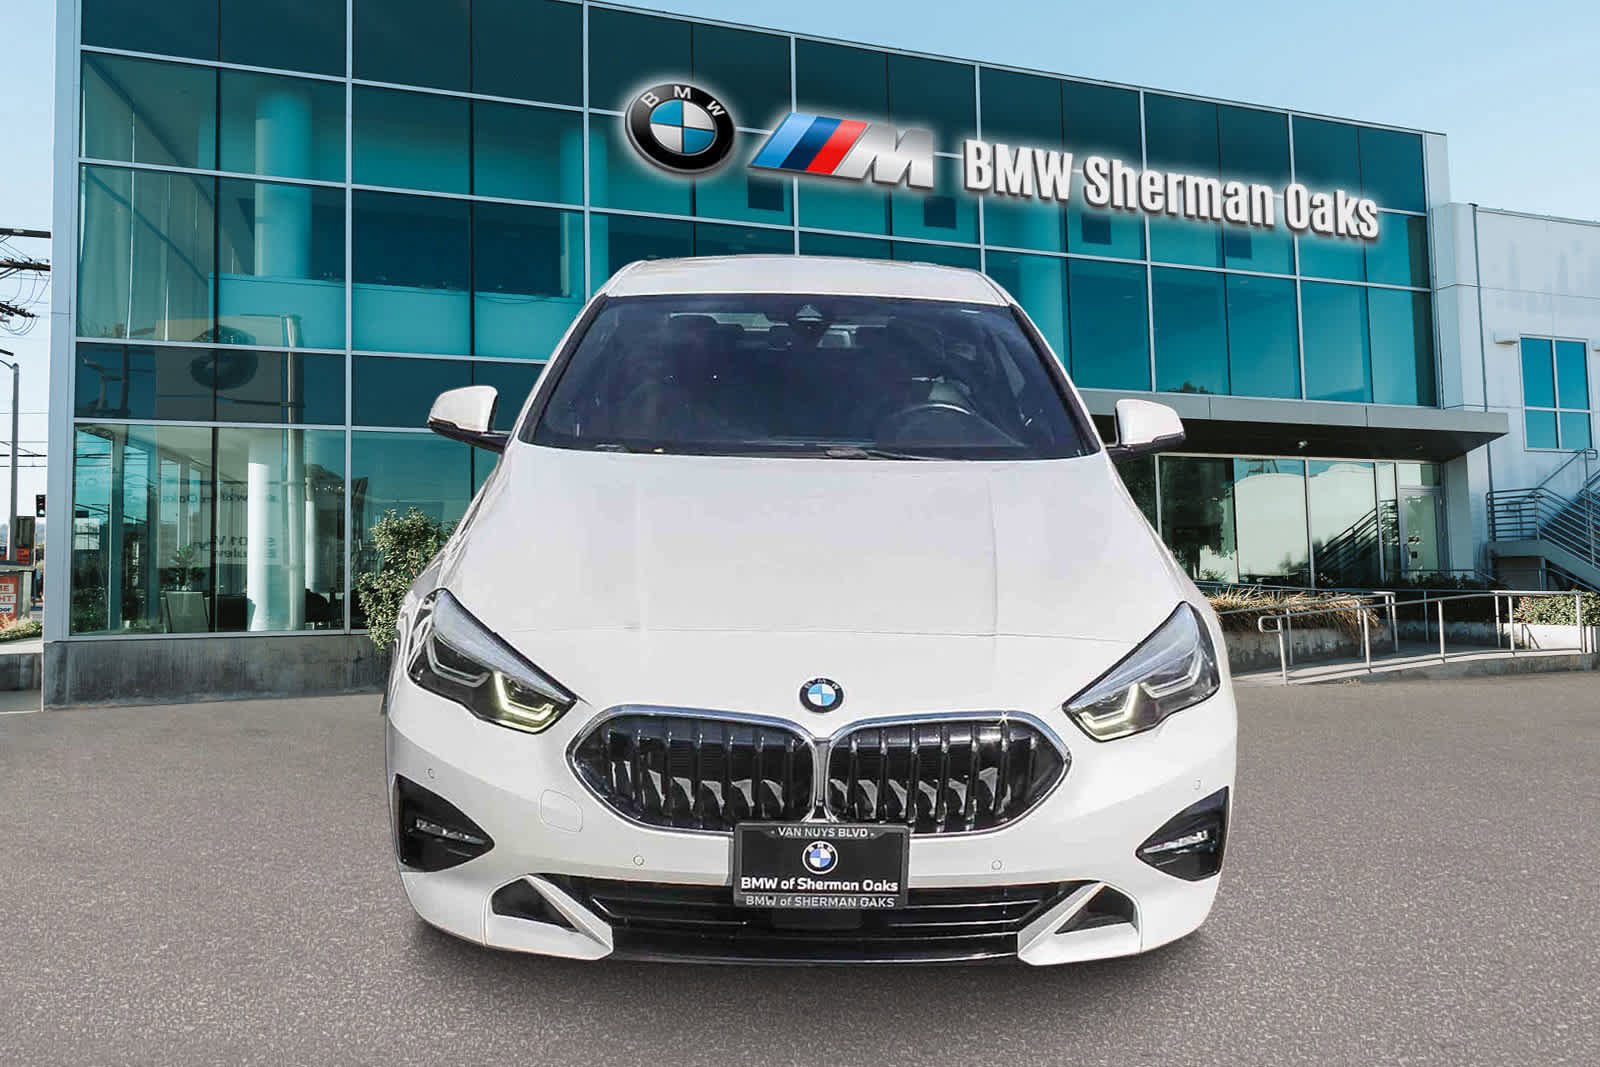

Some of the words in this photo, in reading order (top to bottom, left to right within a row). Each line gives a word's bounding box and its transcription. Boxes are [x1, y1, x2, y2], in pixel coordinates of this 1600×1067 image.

[641, 84, 726, 118] BMW
[963, 138, 1073, 201] BMW
[1083, 156, 1275, 228] Sherman
[1283, 182, 1380, 241] Oaks
[778, 827, 801, 837] VAN
[804, 827, 835, 837] NUYS
[741, 877, 778, 890] BMW
[781, 877, 796, 890] of
[797, 878, 859, 891] Sherman
[862, 879, 898, 892] Oaks
[746, 895, 776, 906] BMW
[780, 896, 792, 906] of
[795, 896, 857, 908] SHERMAN
